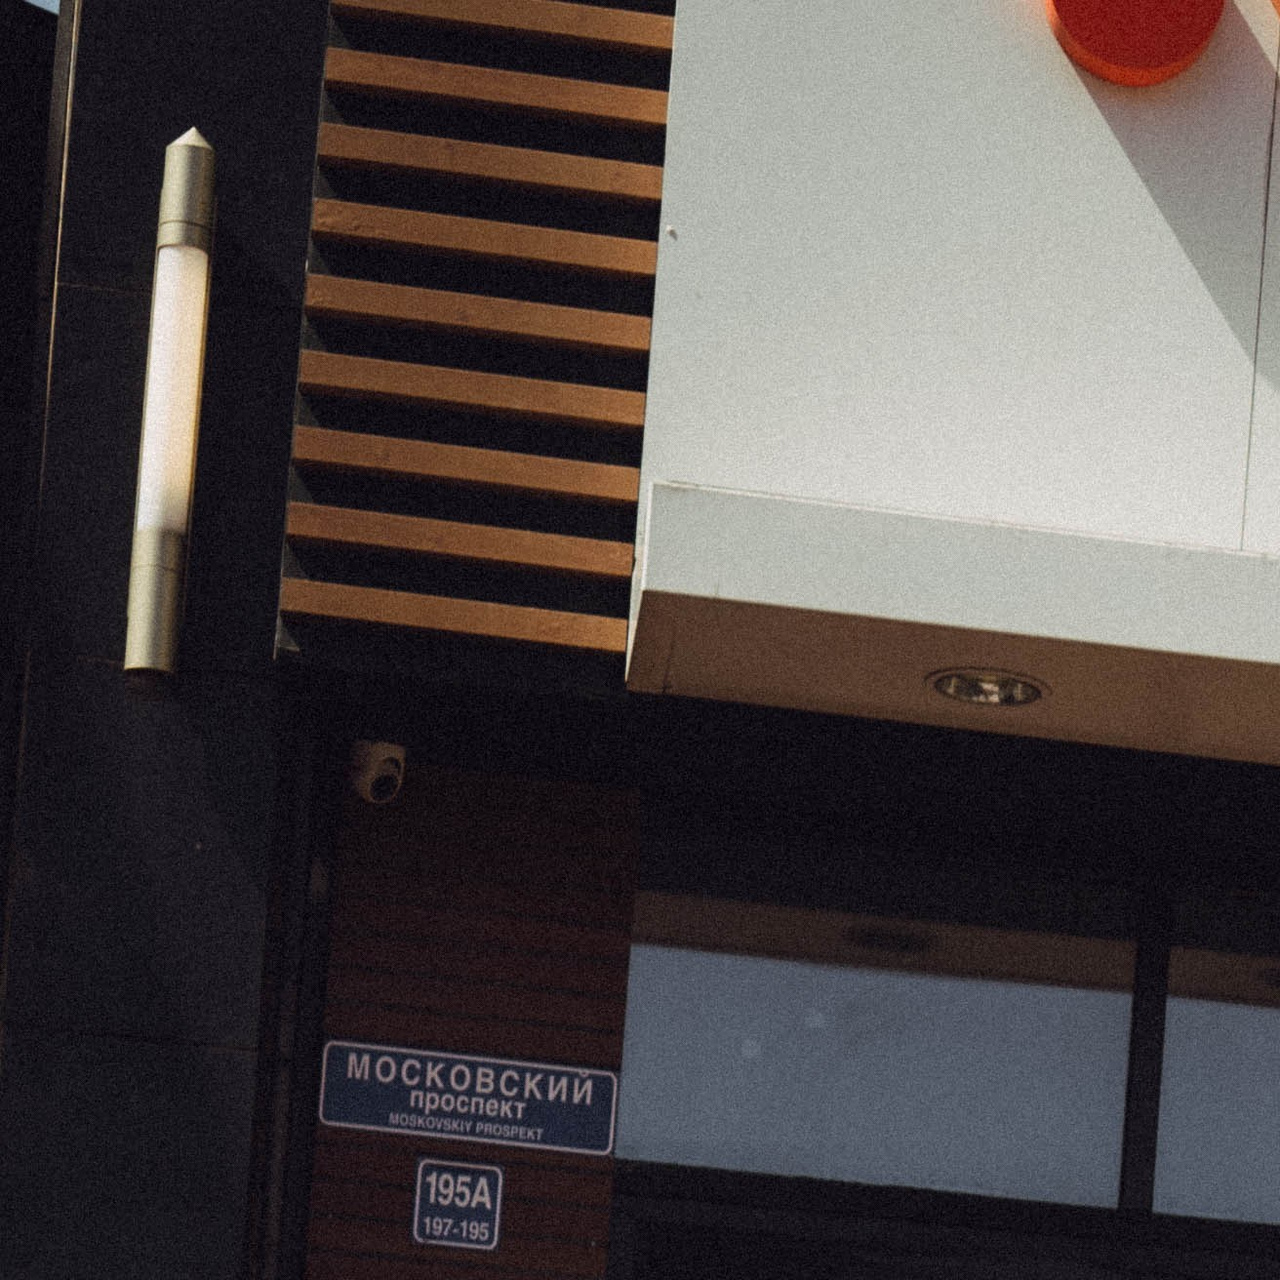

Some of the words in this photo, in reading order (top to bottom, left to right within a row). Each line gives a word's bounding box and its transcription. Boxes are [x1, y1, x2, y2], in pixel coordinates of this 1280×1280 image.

[347, 1053, 593, 1106] МОСКОВСКИЙ
[409, 1088, 527, 1120] проспект
[388, 1112, 473, 1134] MOSKOVSKIY
[476, 1122, 544, 1141] PROSPEKT
[425, 1171, 492, 1210] 195А
[423, 1215, 490, 1242] 197-195
